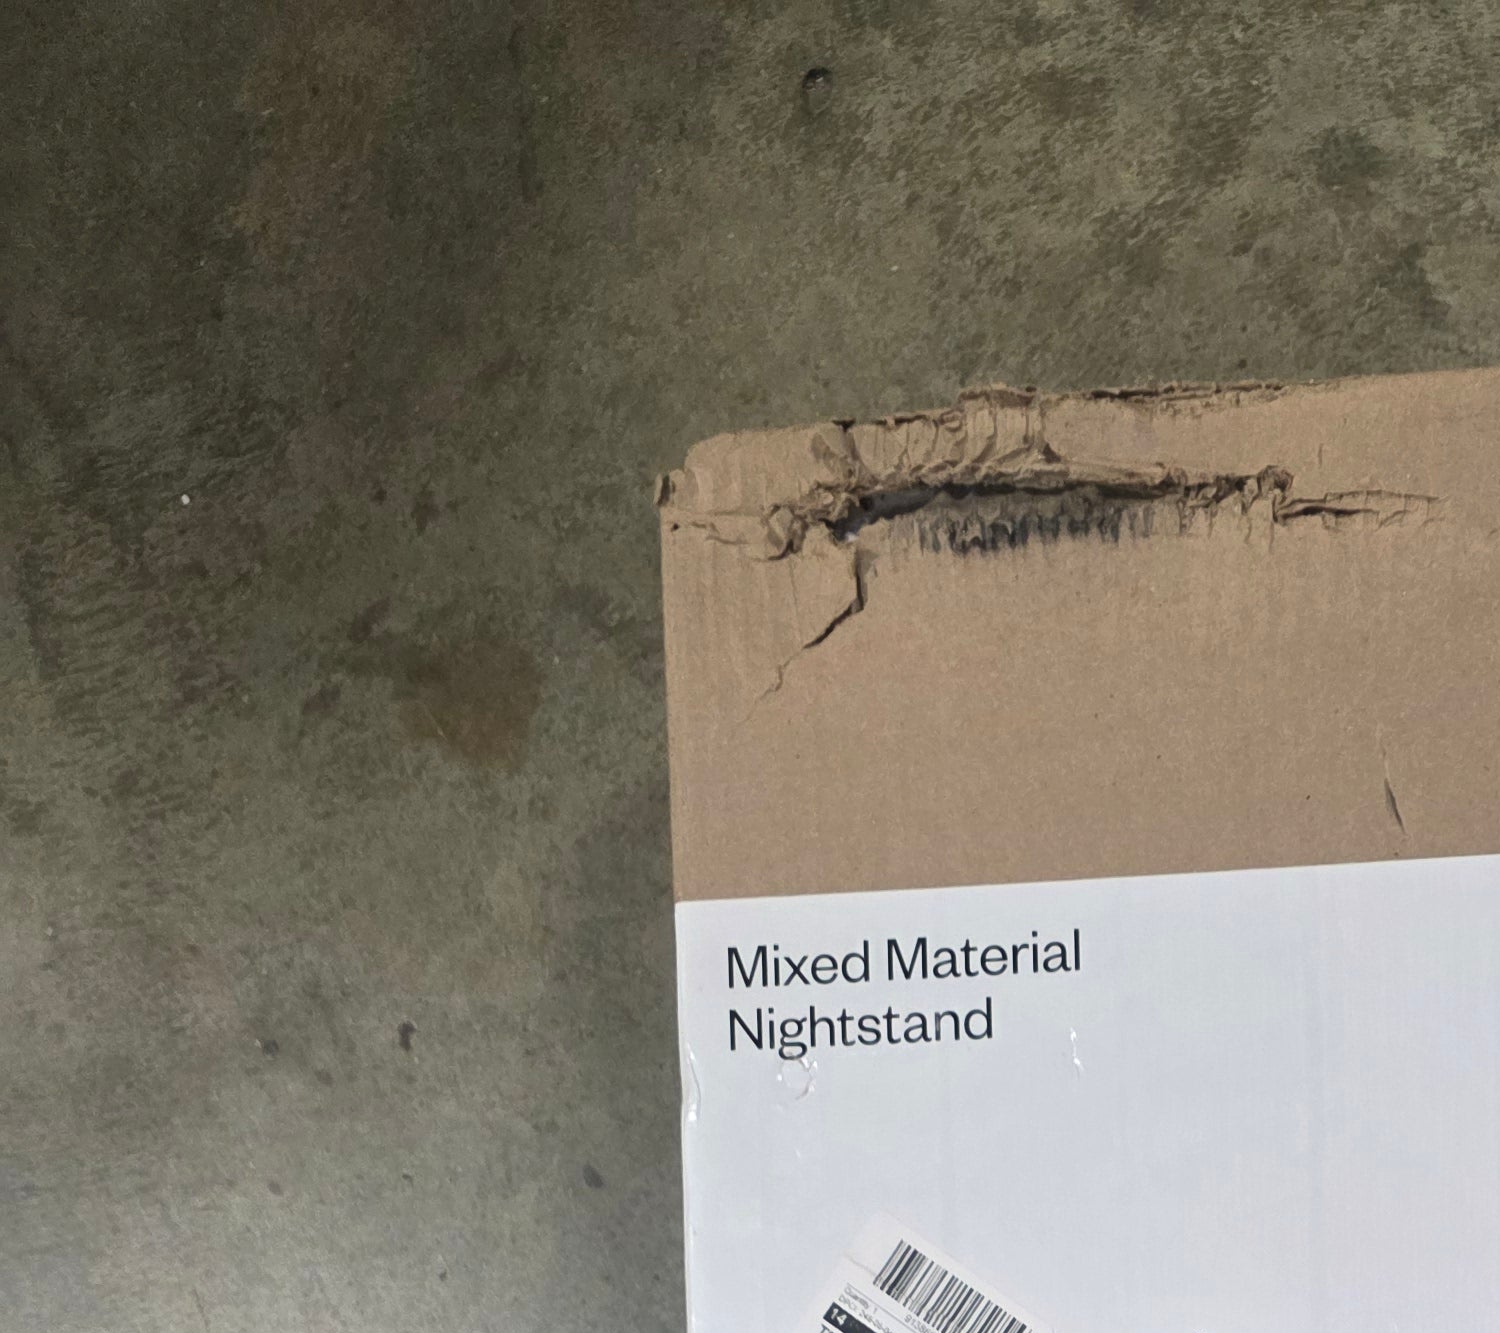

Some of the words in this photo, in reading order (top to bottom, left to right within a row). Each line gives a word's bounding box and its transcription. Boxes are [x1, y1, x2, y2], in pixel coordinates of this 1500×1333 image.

[727, 940, 870, 988] Mixed
[886, 929, 1082, 980] Material
[728, 998, 994, 1060] Nightstand
[828, 1306, 849, 1327] 14
